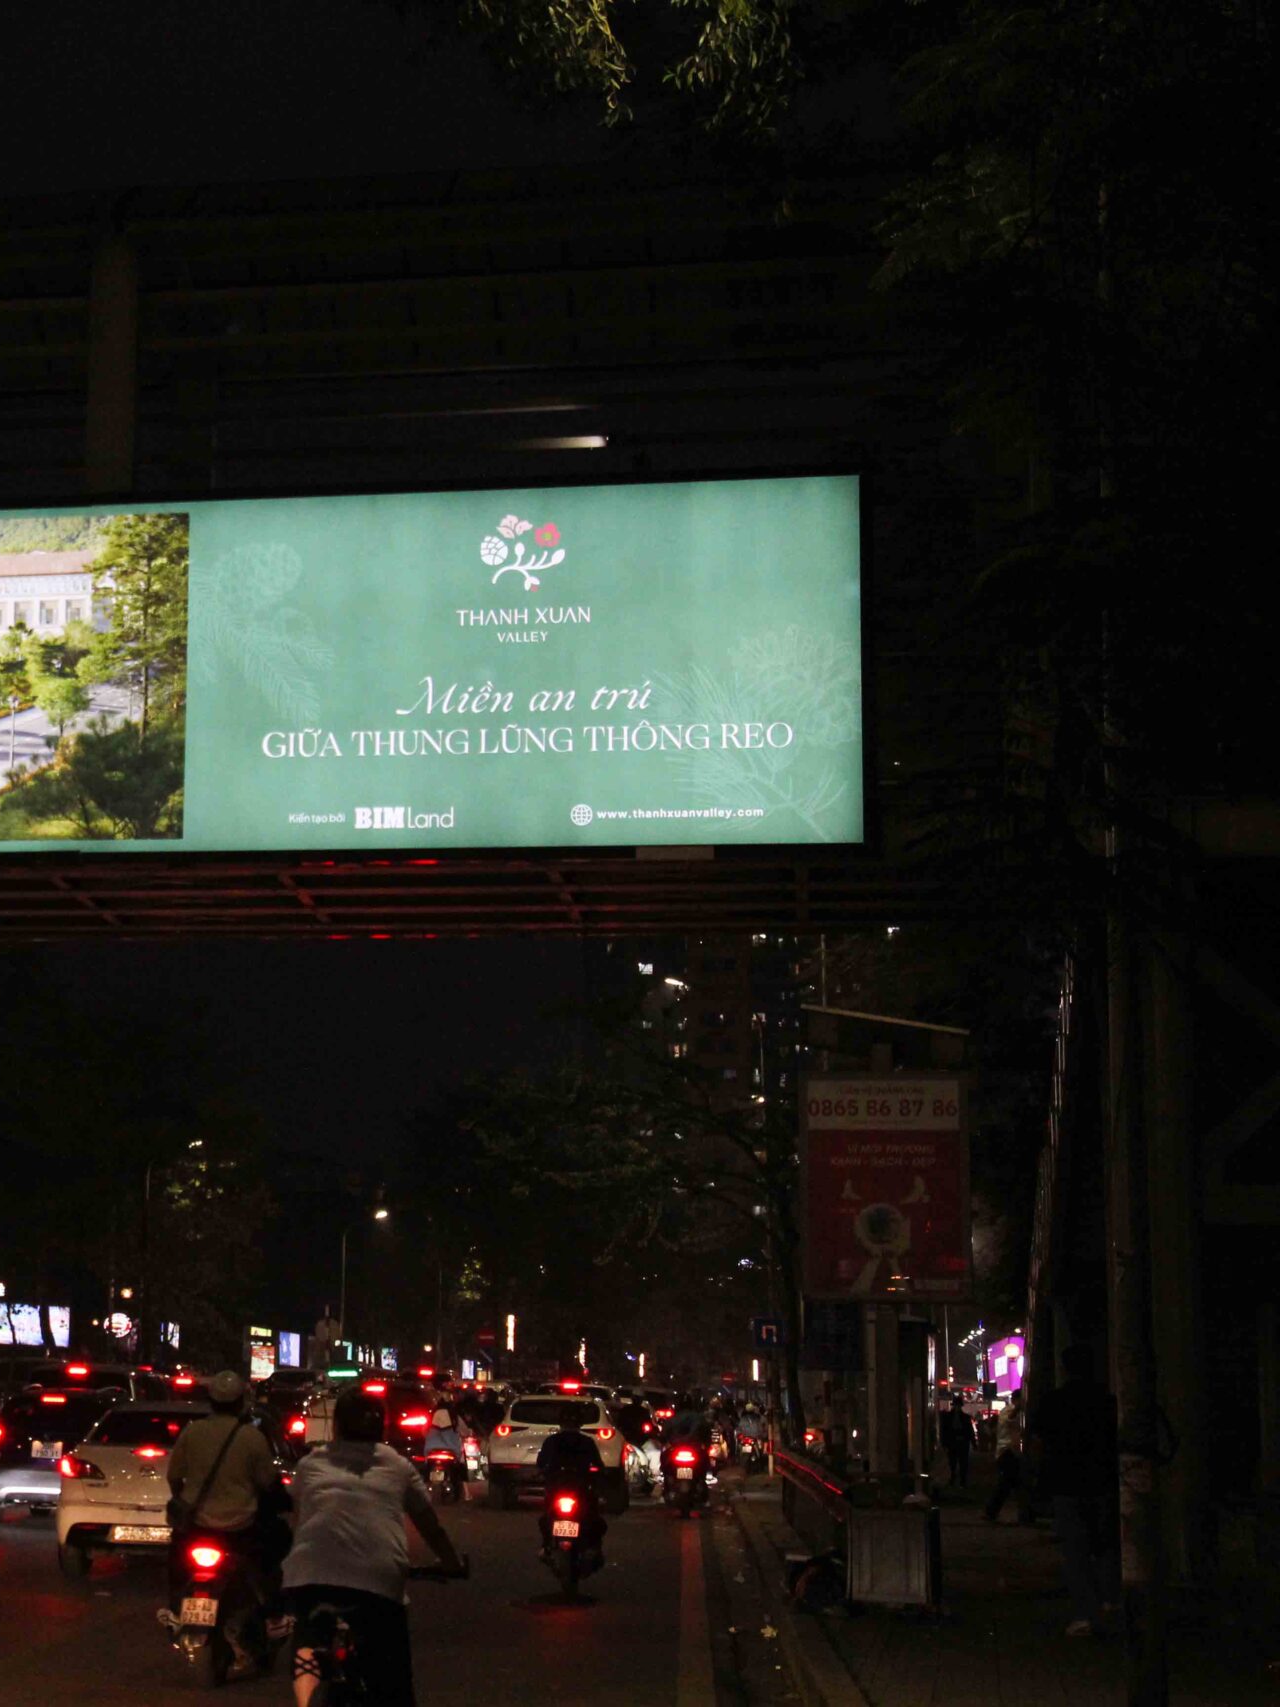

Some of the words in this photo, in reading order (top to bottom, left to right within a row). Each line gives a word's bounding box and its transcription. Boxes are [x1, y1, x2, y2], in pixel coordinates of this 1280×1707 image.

[456, 608, 528, 626] THANH
[535, 606, 591, 624] XUAN
[497, 631, 548, 642] VALLEY
[395, 676, 514, 714] Miền
[529, 689, 575, 711] an
[590, 680, 651, 711] trú
[262, 728, 342, 758] GIỮA
[352, 730, 468, 757] THUNG
[478, 723, 574, 755] LŨNG
[583, 719, 710, 753] THÔNG
[720, 722, 793, 750] REO
[354, 807, 405, 829] BIM
[407, 806, 454, 829] Land
[597, 807, 764, 820] www.thanhxuanvalley.com
[808, 1099, 858, 1117] 0865
[900, 1099, 924, 1117] 87
